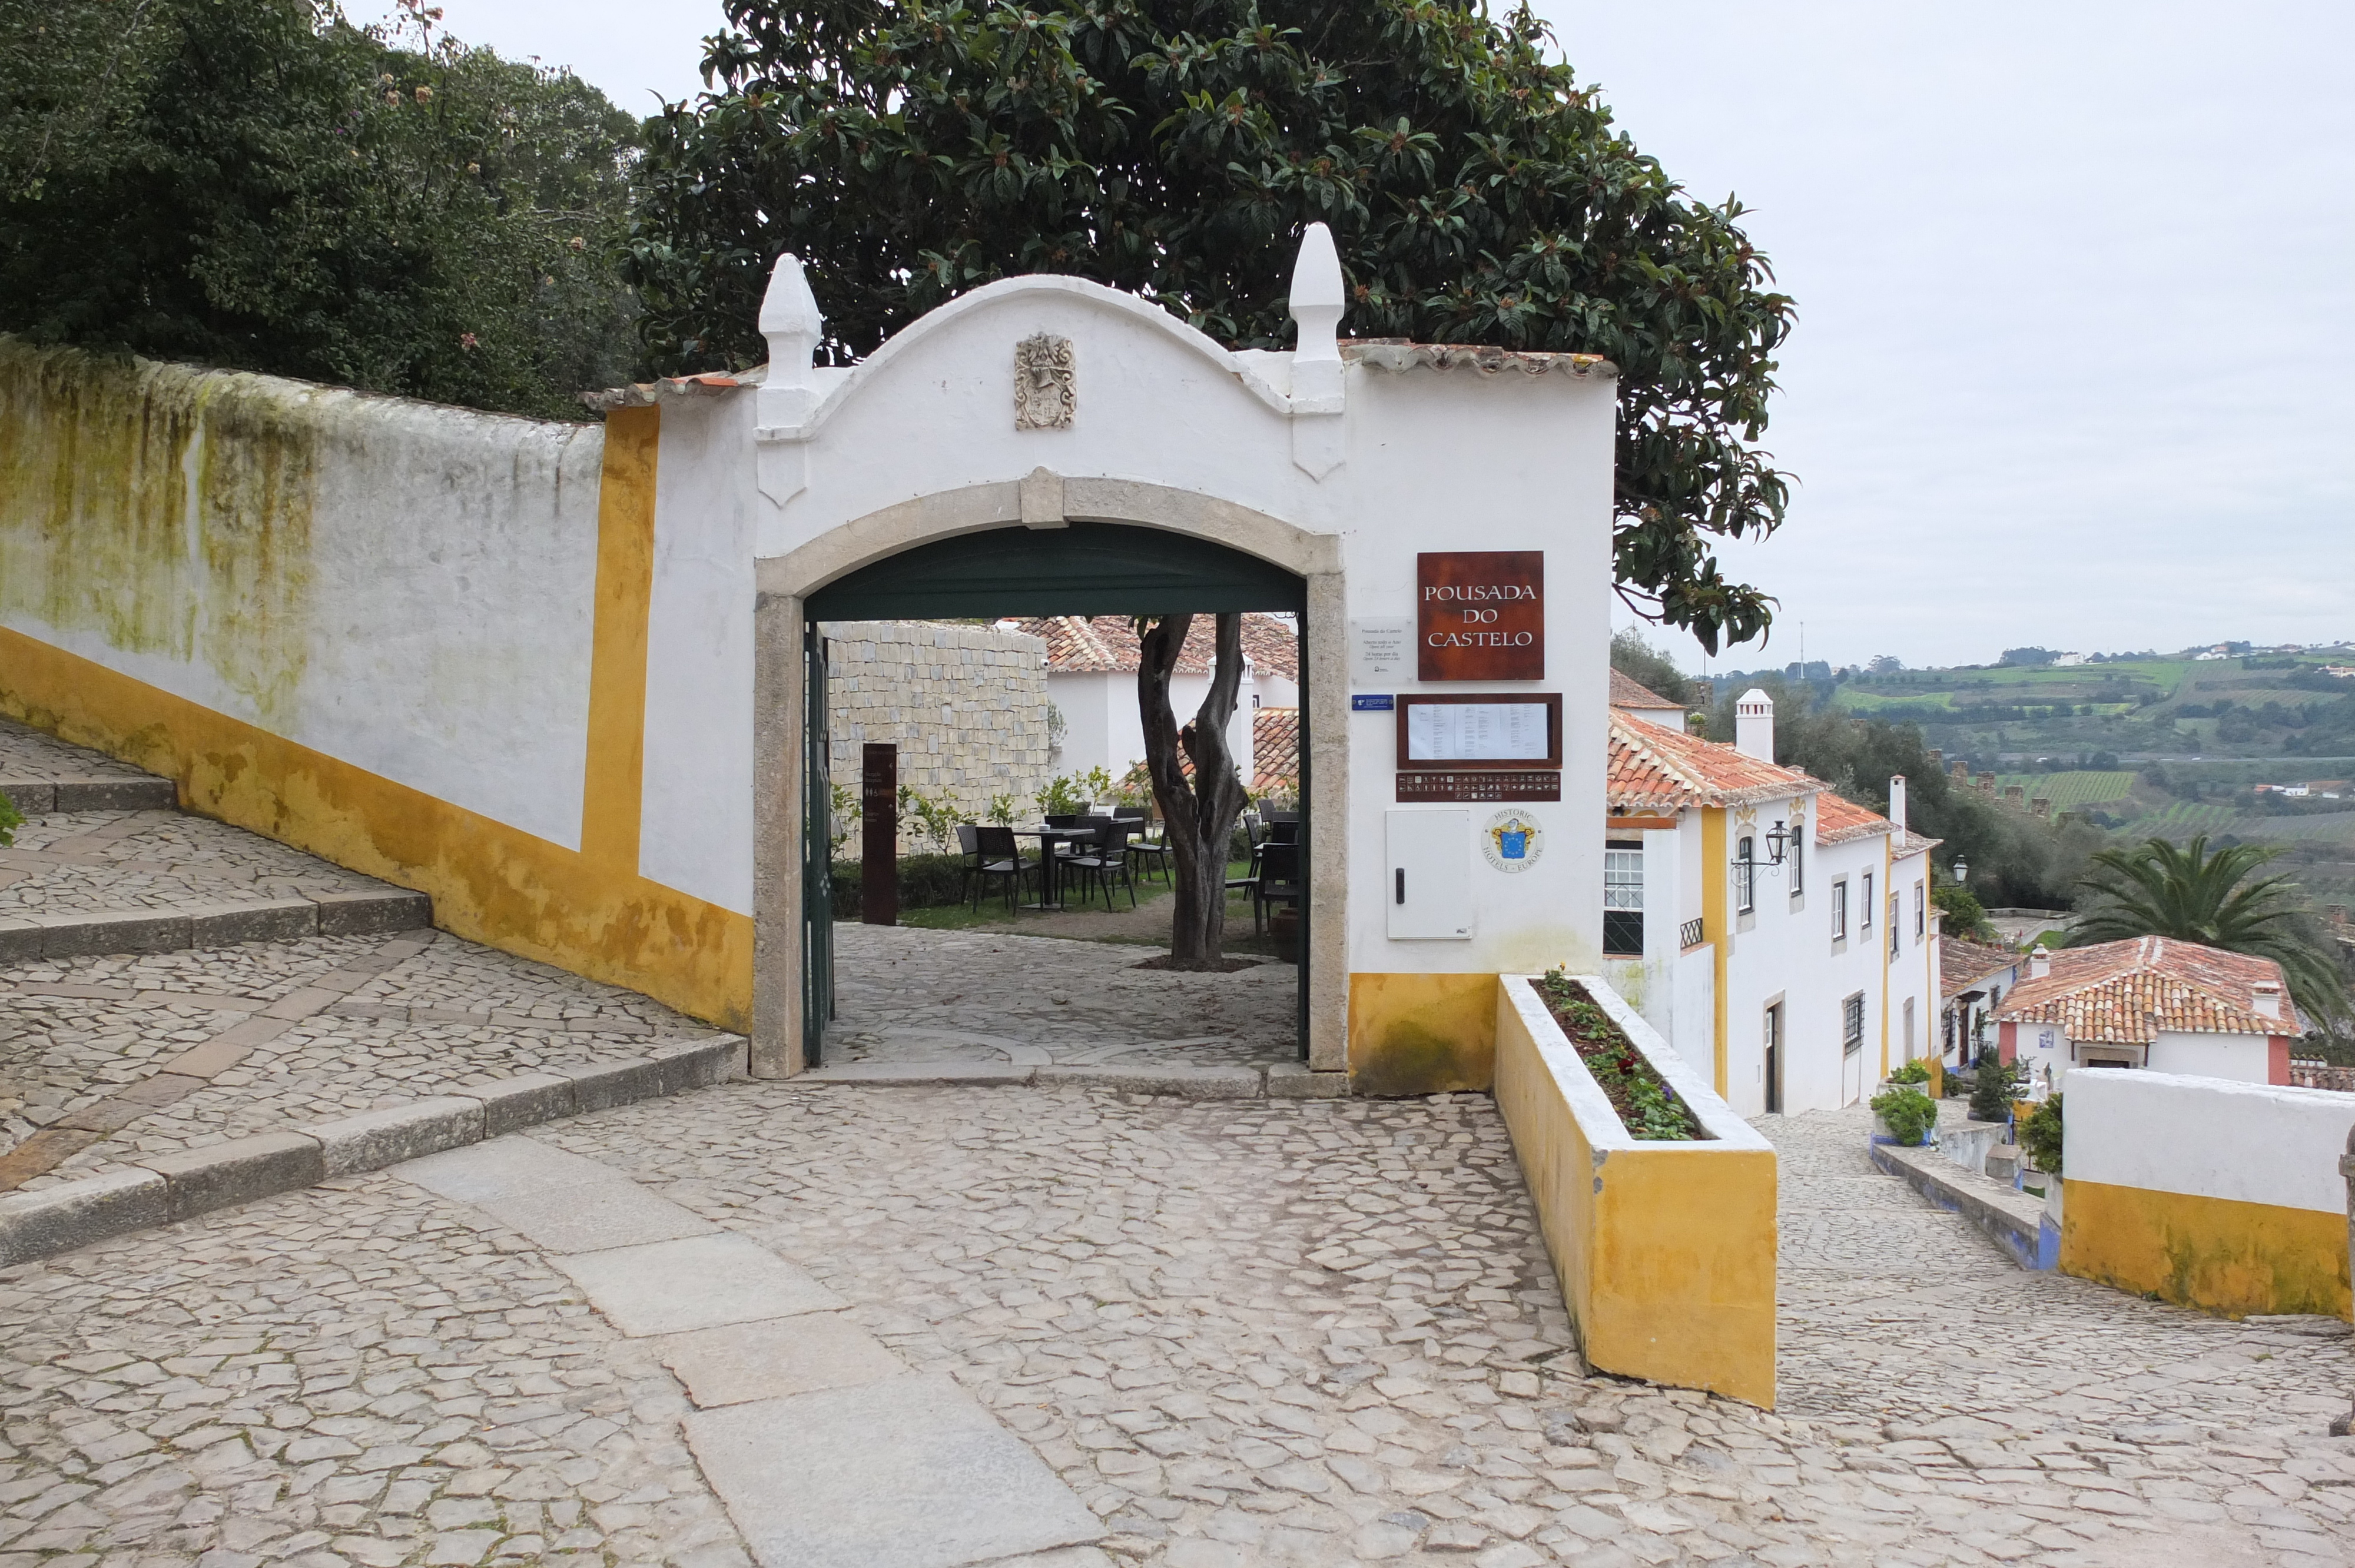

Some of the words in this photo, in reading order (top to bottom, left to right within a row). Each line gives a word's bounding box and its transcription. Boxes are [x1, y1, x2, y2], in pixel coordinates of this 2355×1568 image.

[1424, 585, 1537, 601] POUSADA
[1462, 609, 1498, 623] DO
[1428, 632, 1533, 647] CASTELO
[1494, 809, 1534, 822] HISTORIC
[1484, 846, 1508, 871] HOTELS
[1517, 848, 1543, 871] EUROPE
